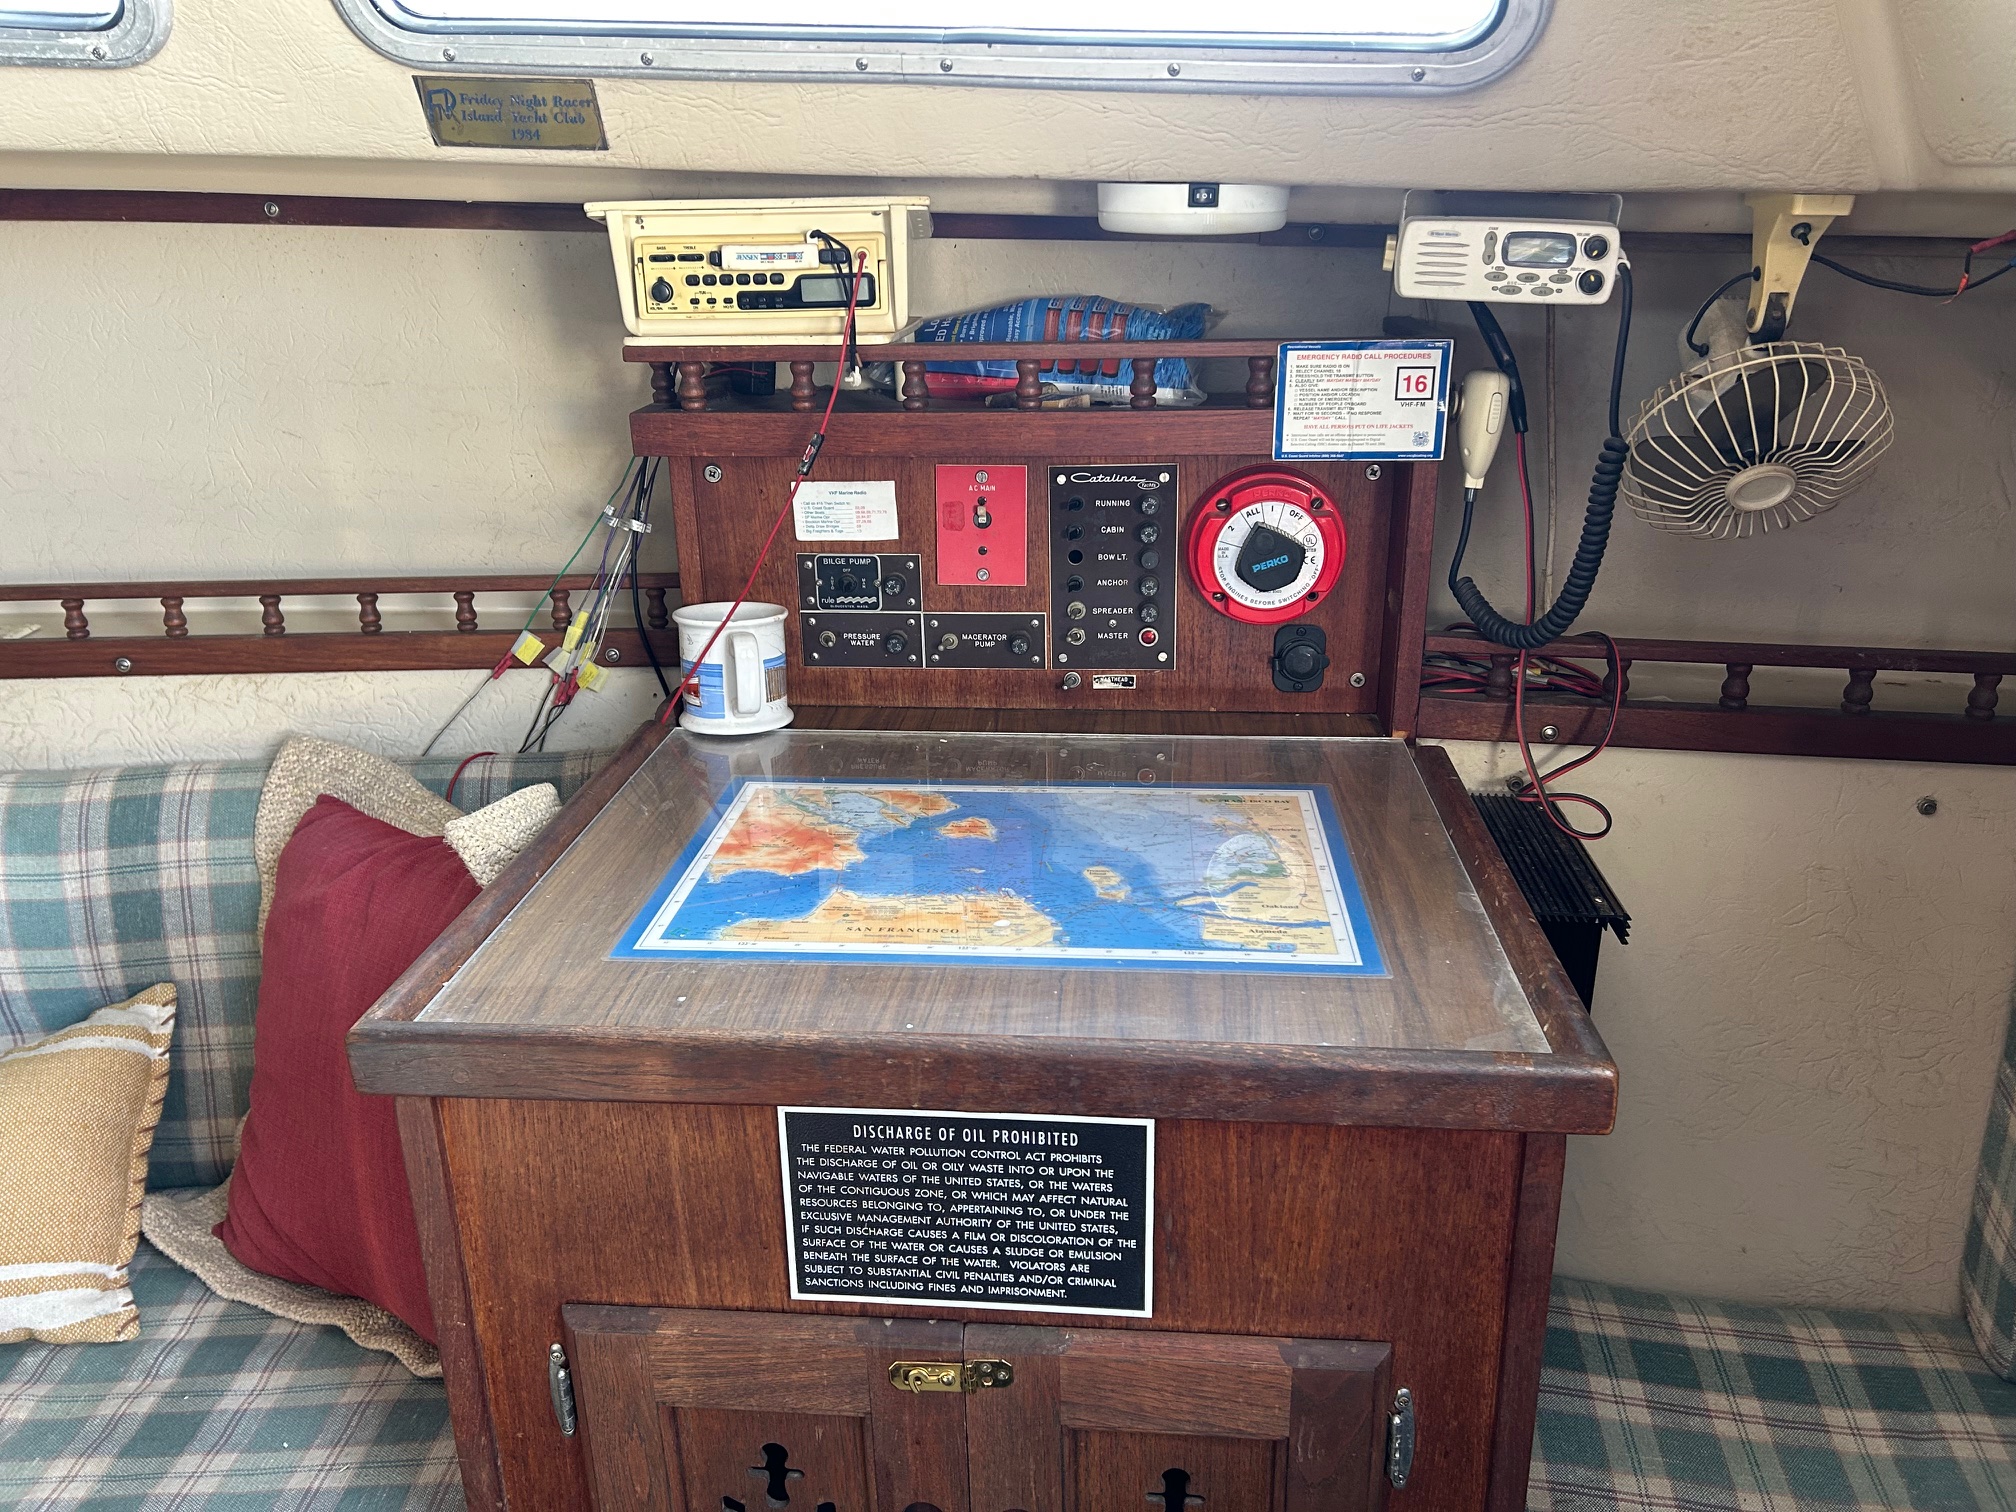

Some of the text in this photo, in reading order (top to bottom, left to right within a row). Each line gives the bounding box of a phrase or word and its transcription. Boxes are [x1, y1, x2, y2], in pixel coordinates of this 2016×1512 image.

[459, 93, 592, 111] Friday Night Racer
[461, 110, 585, 124] Island Yacht Club
[511, 129, 541, 140] 1984
[1402, 375, 1428, 393] 16
[1070, 472, 1146, 483] Catalina
[1246, 508, 1261, 518] ALL
[1289, 510, 1304, 521] OFF
[1252, 554, 1289, 573] PERKO
[1225, 581, 1249, 602] ENGINES
[1278, 582, 1311, 604] SWITCHING
[1092, 607, 1133, 615] SPREADER
[853, 1124, 1078, 1146] DISCHARGE OF OIL PROHIBITED
[801, 1143, 1102, 1164] THE FEDERAL WATER POLLUTION CONTROL ACT PROHIBITS
[796, 1157, 1114, 1178] THE DISCHARGE OF OIL OR OILY WASTE INTO OR UPON THE
[797, 1170, 1113, 1192] NAVIGABLE WATERS OF THE UNITED STATES, OR THE WATERS
[798, 1184, 1128, 1207] OF THE CONTIGUOUS ZONE, OR WHICH MAY AFFECT NATURAL
[799, 1198, 1129, 1221] RESOURCES BELONGING TO, APPERTAINING TO, OR UNDER THE
[800, 1211, 1118, 1235] EXCLUSIVE MANAGEMENT AUTHORITY OF THE UNITED STATES,
[801, 1224, 1136, 1248] IF SUCH DISCHARGE CAUSES A FILM OR DISCOLORATION OF THE
[802, 1238, 1121, 1261] SURFACE OF THE WATER OR CAUSES A SLUDGE OR EMULSION
[803, 1251, 1089, 1273] BENEATH THE SURFACE OF THE WATER. VIOLATORS ARE
[804, 1264, 1116, 1288] SUBJECT TO SUBSTANTIAL CIVIL PENALTIES AND/OR CRIMINAL
[805, 1277, 1067, 1298] SANCTIONS INCLUDING FINES AND IMPRISONMENT.
